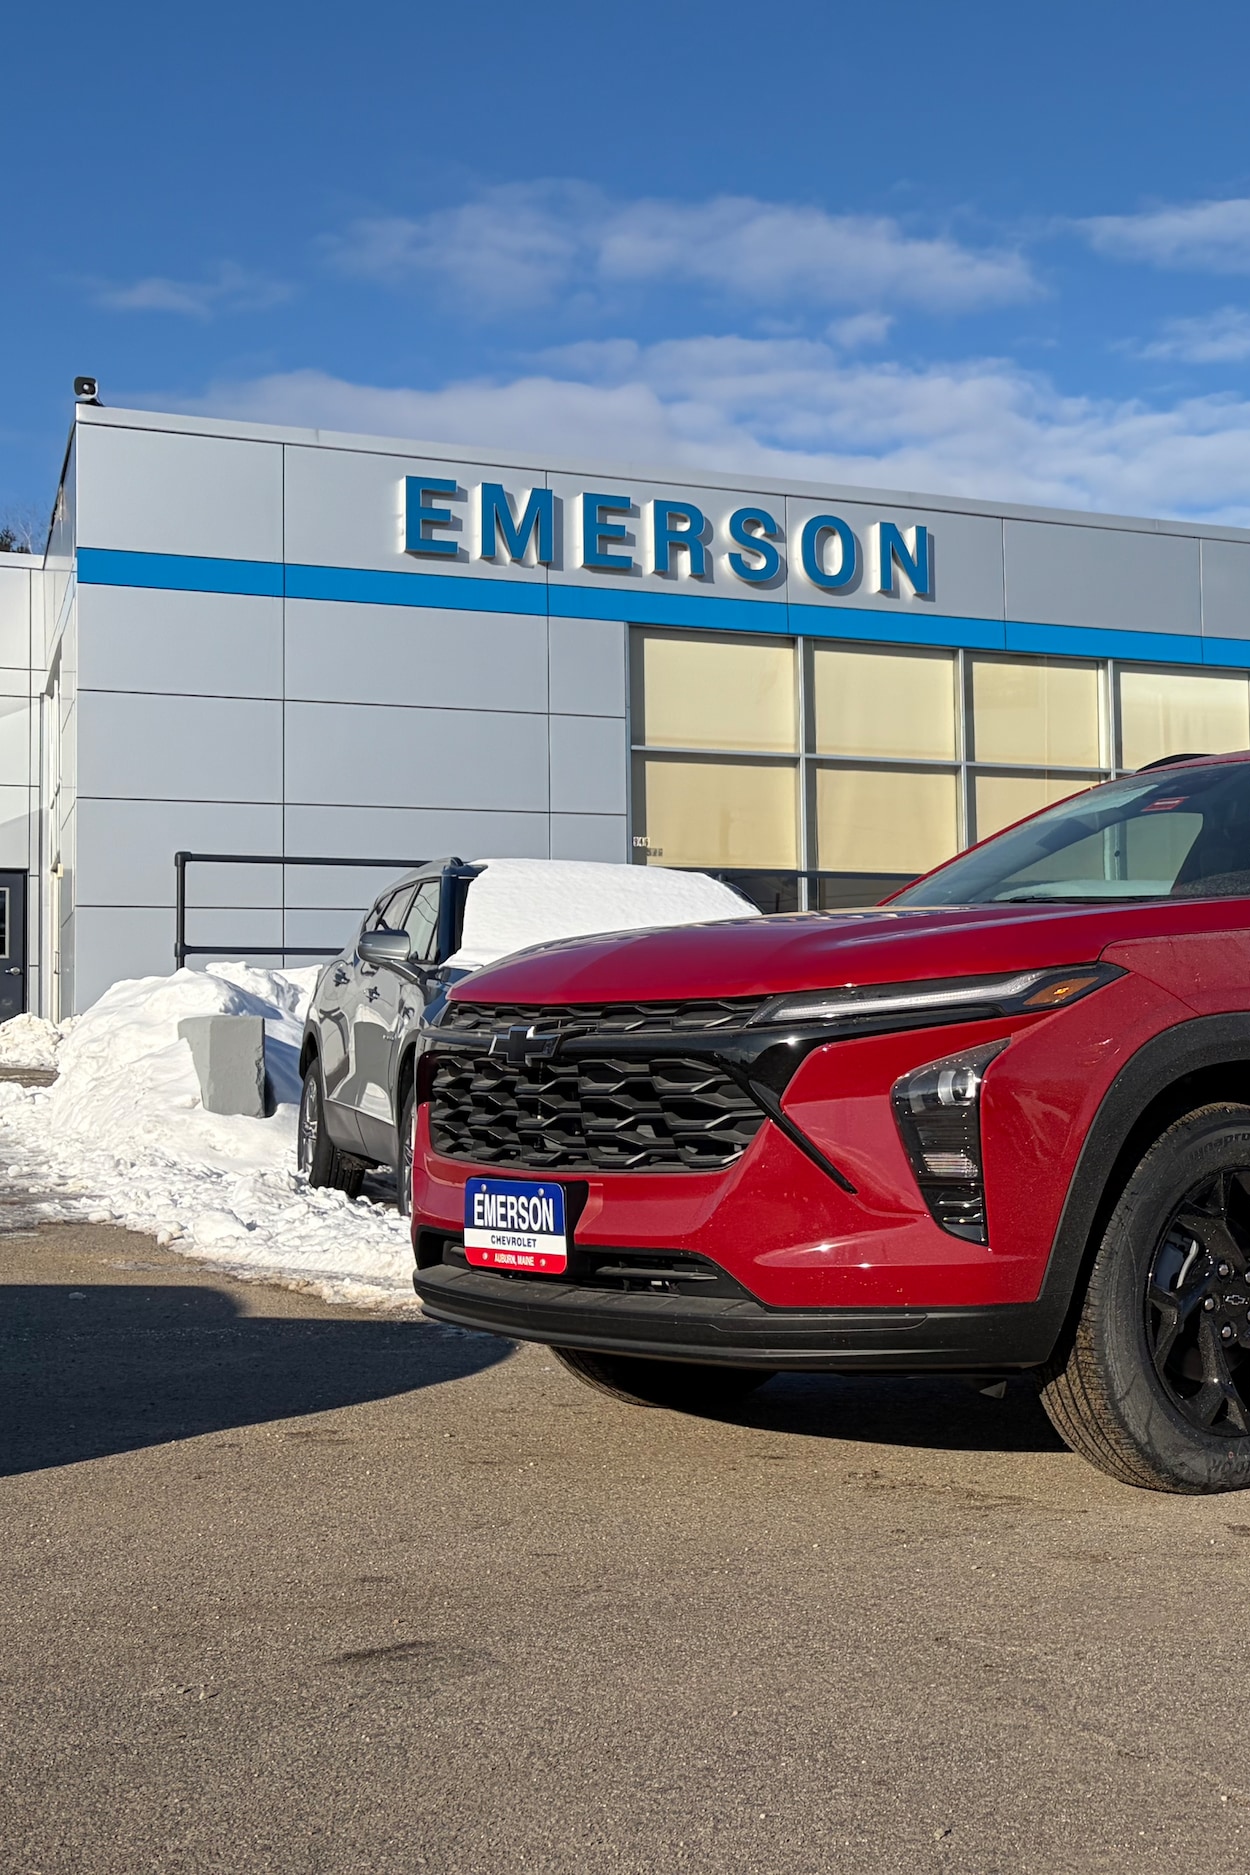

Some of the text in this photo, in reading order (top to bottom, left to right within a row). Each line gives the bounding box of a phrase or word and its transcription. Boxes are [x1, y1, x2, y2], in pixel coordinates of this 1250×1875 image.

[403, 475, 930, 595] EMERSON
[474, 1193, 554, 1231] EMERSON
[490, 1234, 537, 1248] CHEVROLET
[495, 1253, 534, 1266] AUBURN, MAINE
